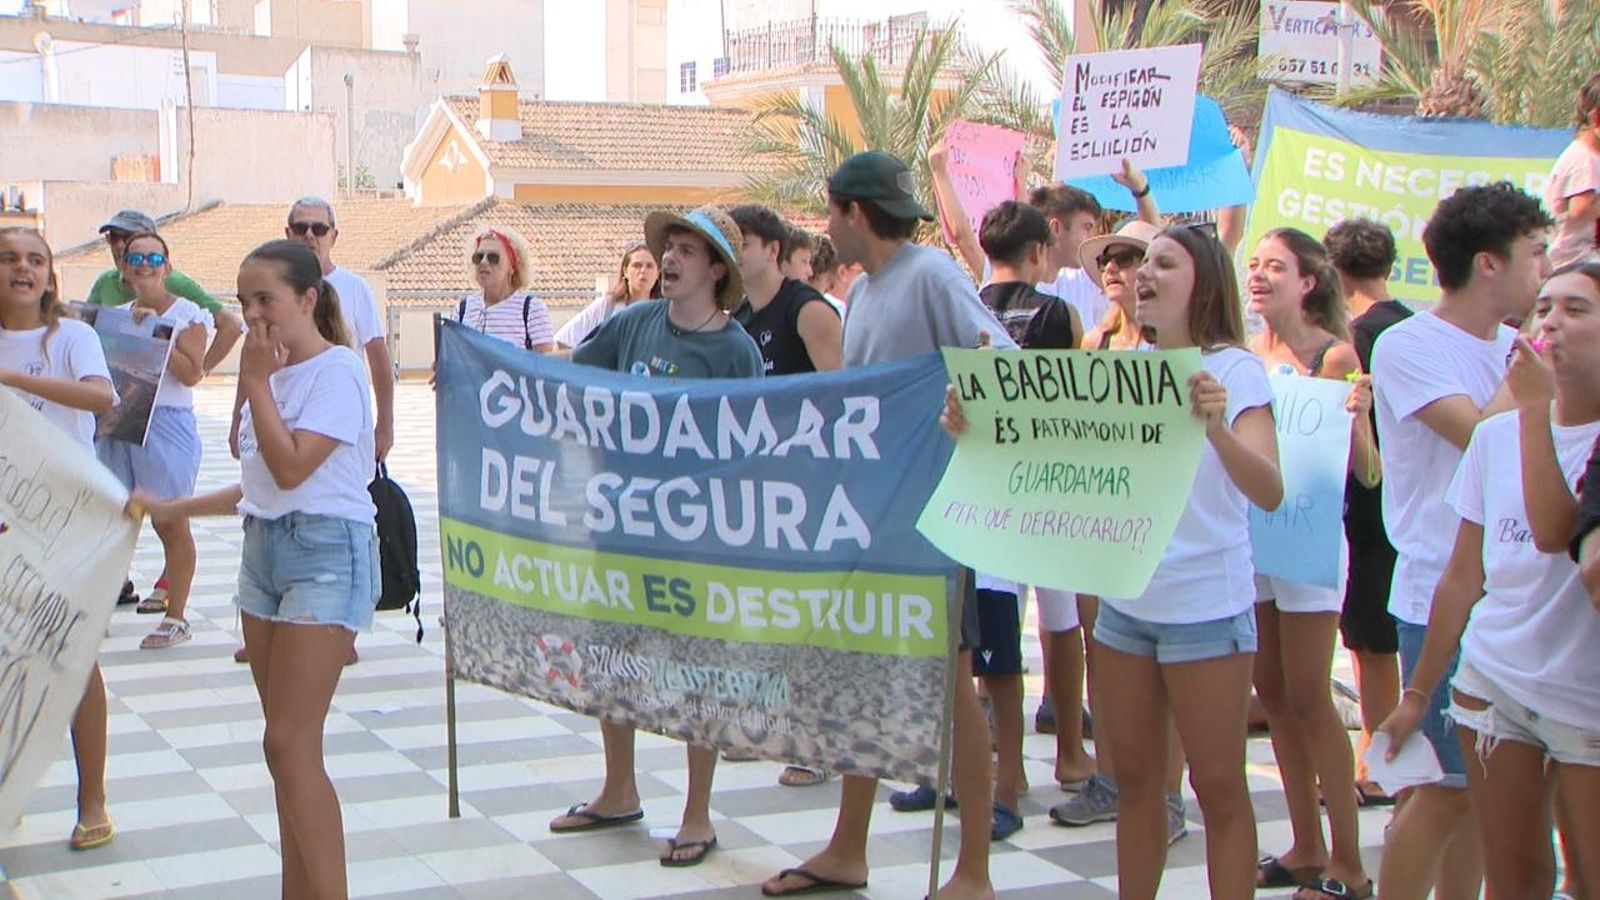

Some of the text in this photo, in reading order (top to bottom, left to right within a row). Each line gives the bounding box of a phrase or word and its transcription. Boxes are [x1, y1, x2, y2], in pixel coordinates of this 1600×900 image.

[1075, 61, 1171, 95] MODIFICAR
[1310, 60, 1327, 76] 51
[1072, 86, 1162, 112] EL ESPIGÓN
[1071, 113, 1132, 135] ES LA
[1302, 147, 1346, 182] ES
[957, 372, 987, 402] LA
[479, 369, 881, 460] GUARDAMAR
[1030, 417, 1135, 443] PATRIMONI
[1140, 422, 1166, 445] DE
[1008, 460, 1131, 499] GUARDAMAR
[479, 447, 872, 552] DEL SEGURA
[446, 533, 935, 640] NO ACTUAR ES DESTRUIR
